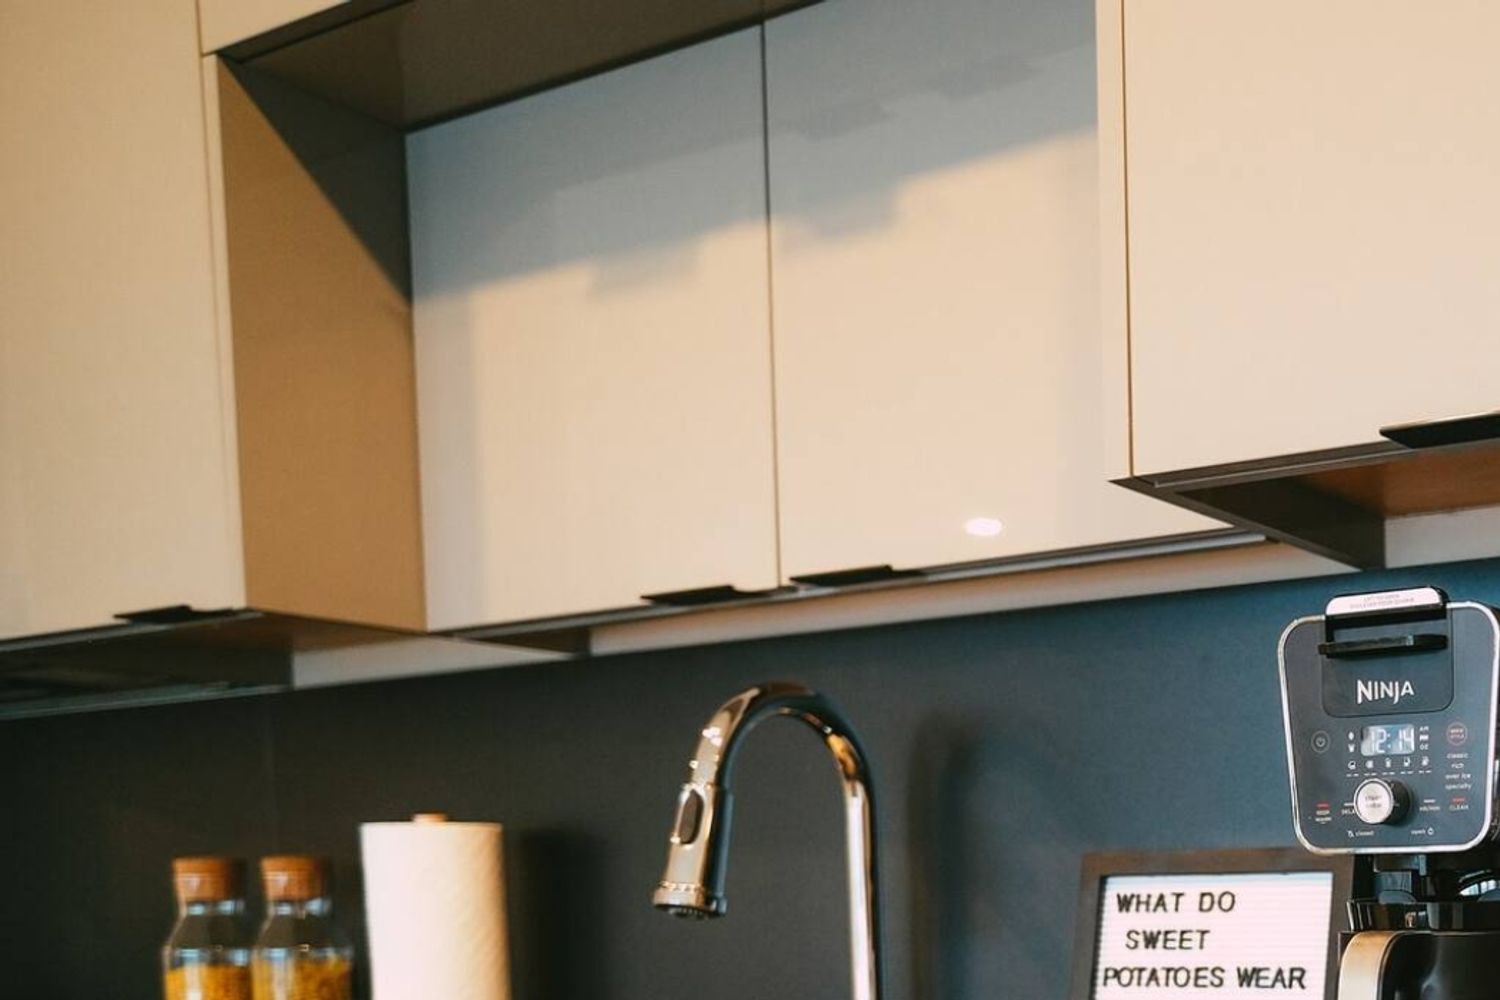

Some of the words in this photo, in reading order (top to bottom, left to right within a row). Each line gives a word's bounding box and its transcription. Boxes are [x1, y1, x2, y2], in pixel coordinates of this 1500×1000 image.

[1357, 679, 1415, 705] NINJA
[1370, 728, 1415, 753] 12:14
[1116, 892, 1185, 913] WHAT
[1198, 891, 1236, 913] DO
[1125, 929, 1211, 951] SWEET
[1103, 966, 1226, 989] POTATOES
[1236, 967, 1307, 990] WEAR
